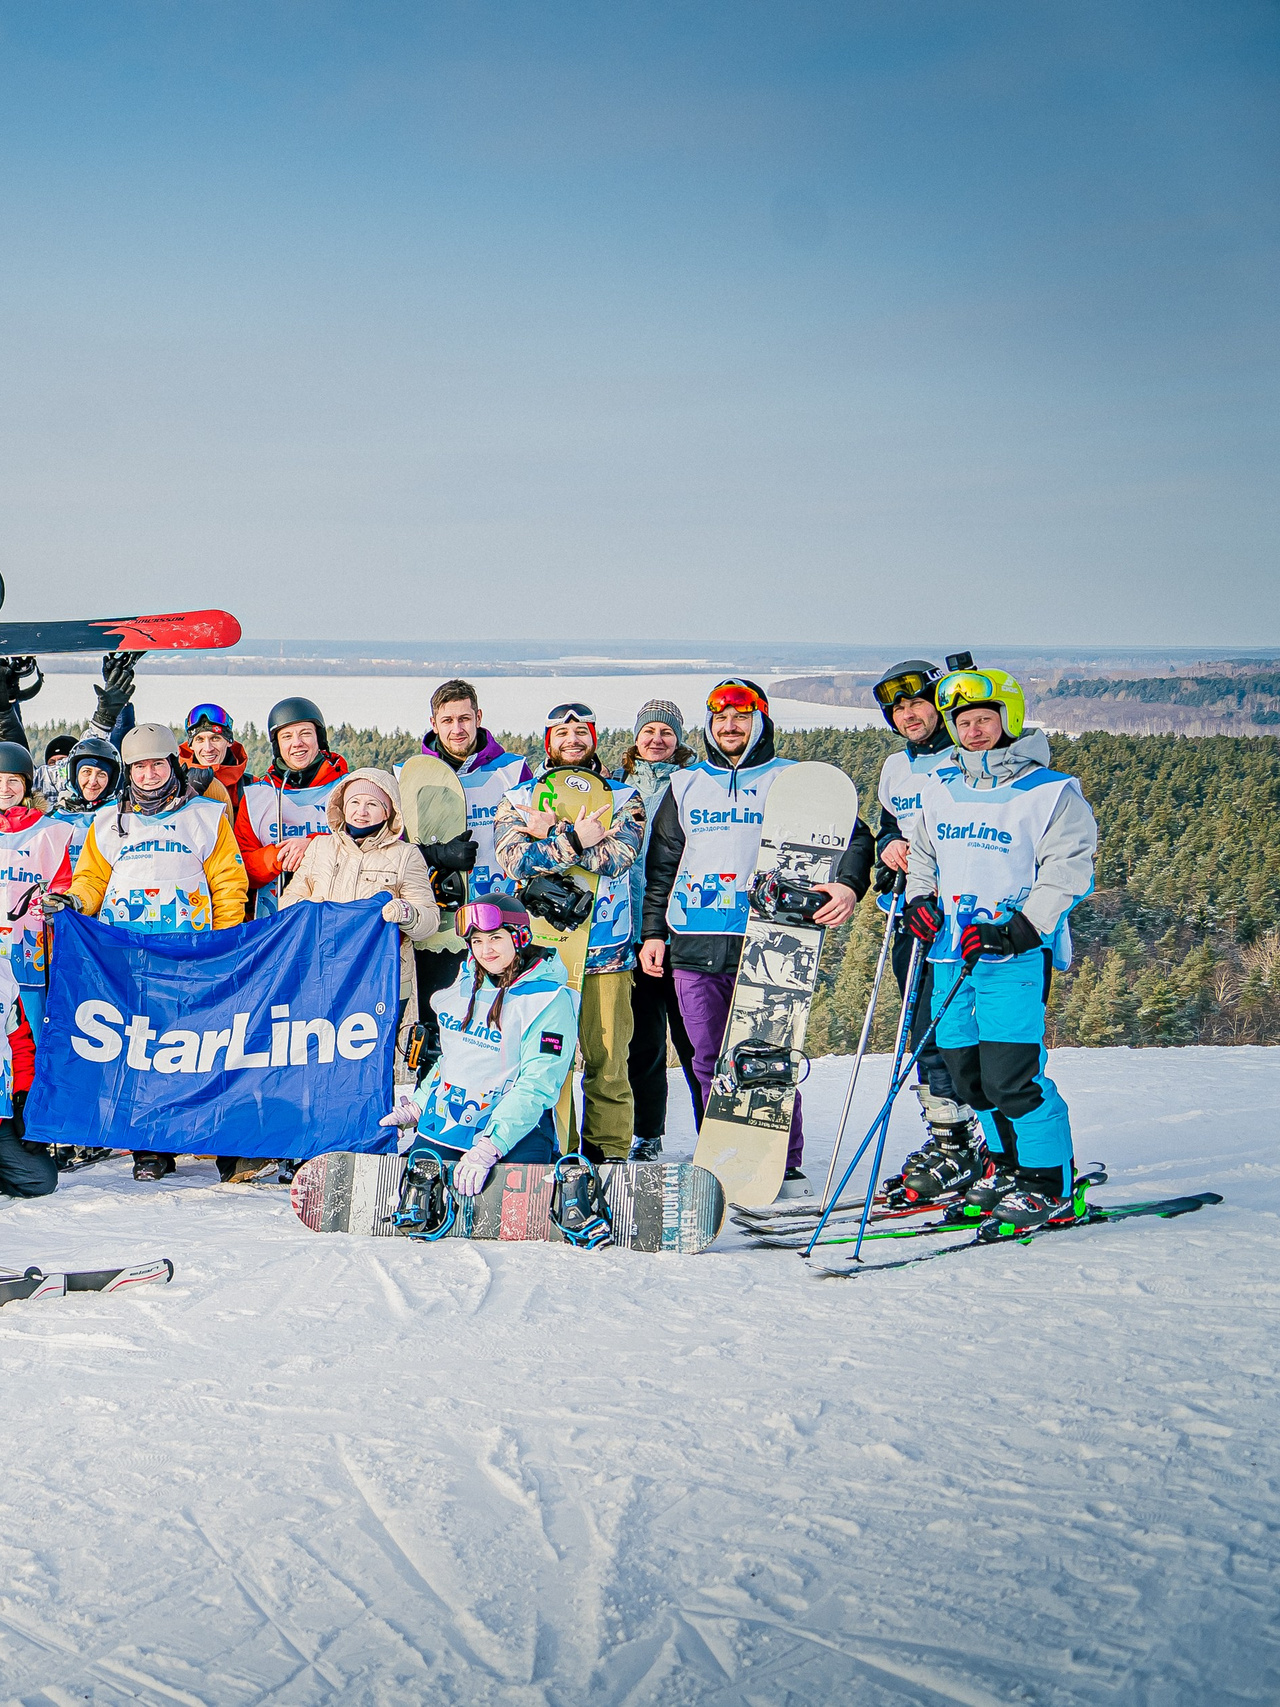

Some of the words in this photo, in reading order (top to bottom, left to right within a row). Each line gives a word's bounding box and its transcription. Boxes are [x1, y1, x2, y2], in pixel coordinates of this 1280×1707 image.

[890, 793, 923, 812] StarL
[689, 807, 764, 825] StarLin
[269, 822, 332, 838] StarLin
[936, 822, 1013, 844] StarLine
[438, 1011, 503, 1043] StaLine
[942, 1168, 972, 1190] HEAD
